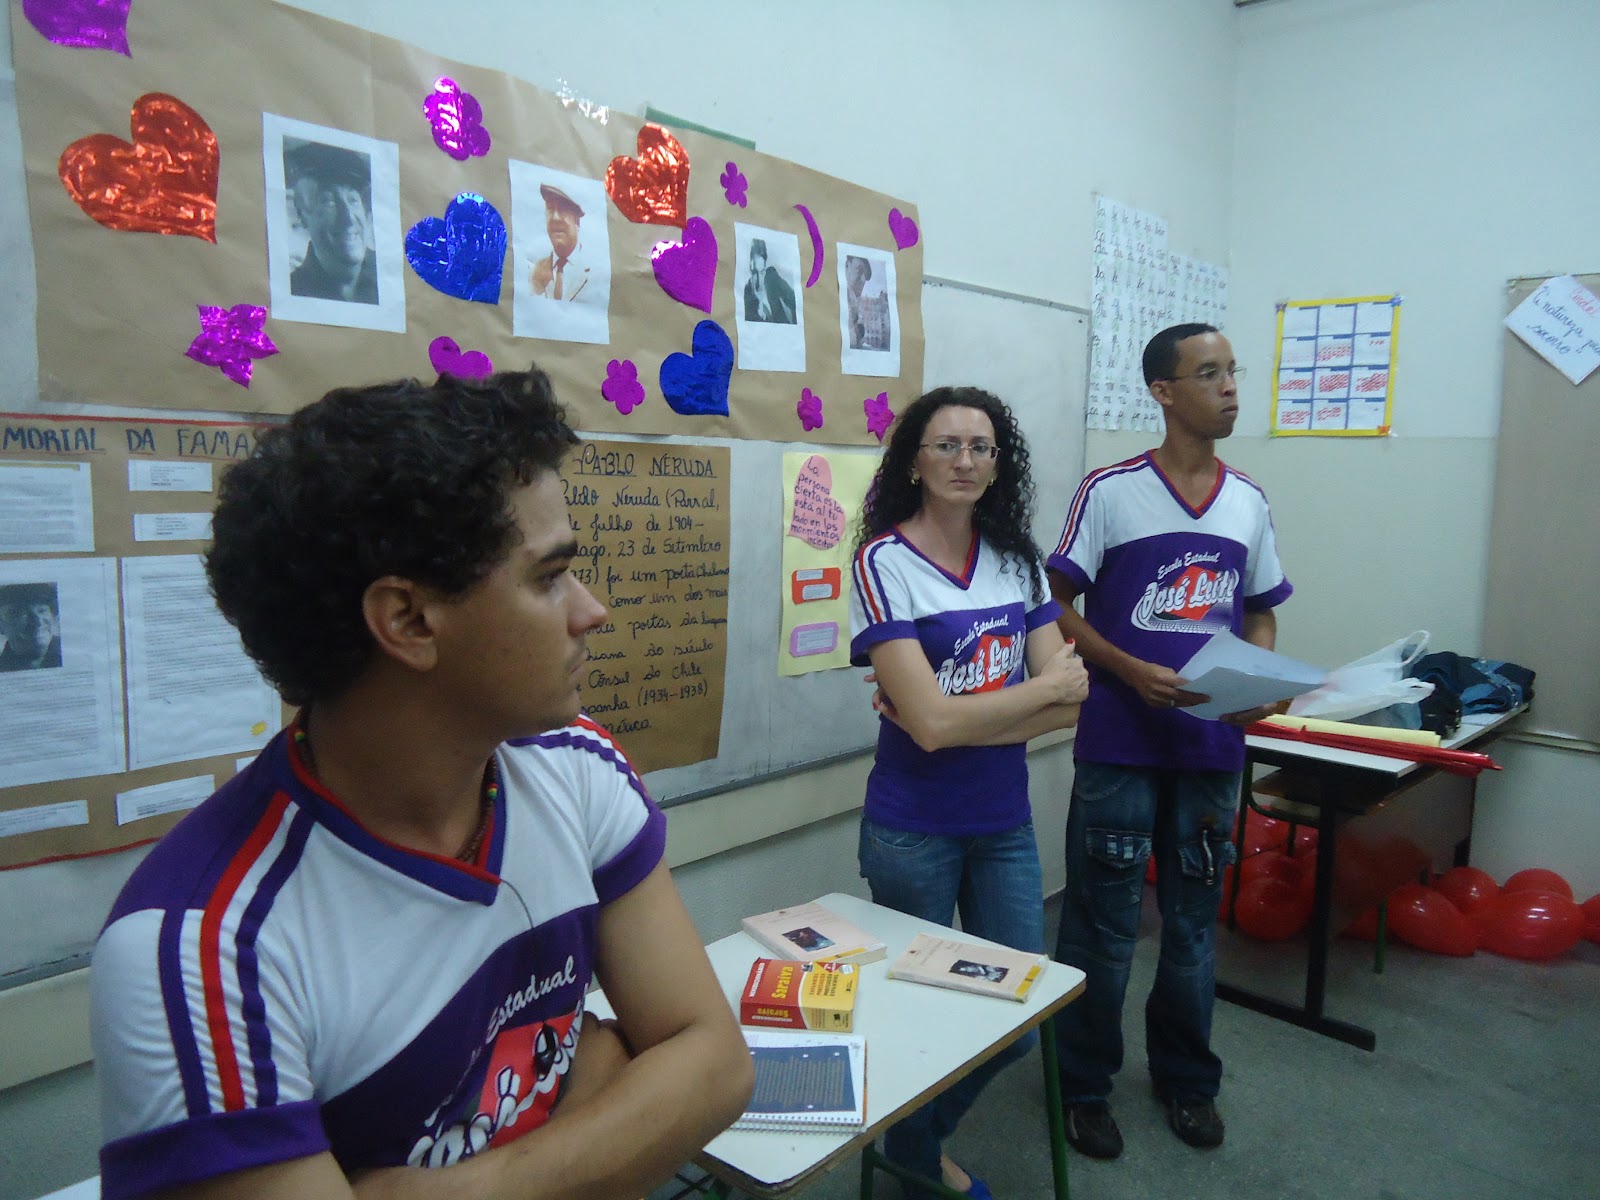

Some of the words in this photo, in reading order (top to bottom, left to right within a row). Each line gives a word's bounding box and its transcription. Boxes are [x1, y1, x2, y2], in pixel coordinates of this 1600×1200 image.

[126, 428, 156, 453] DA
[178, 429, 250, 458] FAMA
[573, 443, 635, 475] PABLO
[649, 453, 714, 477] NERUDA
[612, 484, 660, 507] Neruda
[797, 473, 830, 495] persona
[794, 485, 822, 503] cierta
[824, 497, 832, 506] es
[834, 500, 844, 514] la
[646, 513, 660, 532] de
[793, 509, 808, 525] lado
[810, 518, 820, 527] en
[824, 518, 838, 531] los
[816, 505, 825, 516] al
[828, 509, 838, 520] tu
[618, 540, 635, 557] 23
[642, 536, 656, 555] de
[664, 534, 721, 553] Setembro
[630, 570, 656, 583] um
[1157, 557, 1183, 580] Escola
[1184, 551, 1221, 566] Estadual
[649, 593, 676, 605] um
[684, 584, 703, 601] dos
[1140, 575, 1191, 620] José
[628, 614, 672, 640] poetas
[680, 612, 698, 627] da
[954, 627, 976, 656] Escola
[974, 613, 1009, 637] Estadual
[644, 643, 664, 658] do
[673, 638, 714, 656] século
[643, 665, 660, 681] do
[771, 965, 794, 999] Saraiva
[485, 955, 578, 1045] Estadual
[757, 1007, 790, 1018] Saraiva
